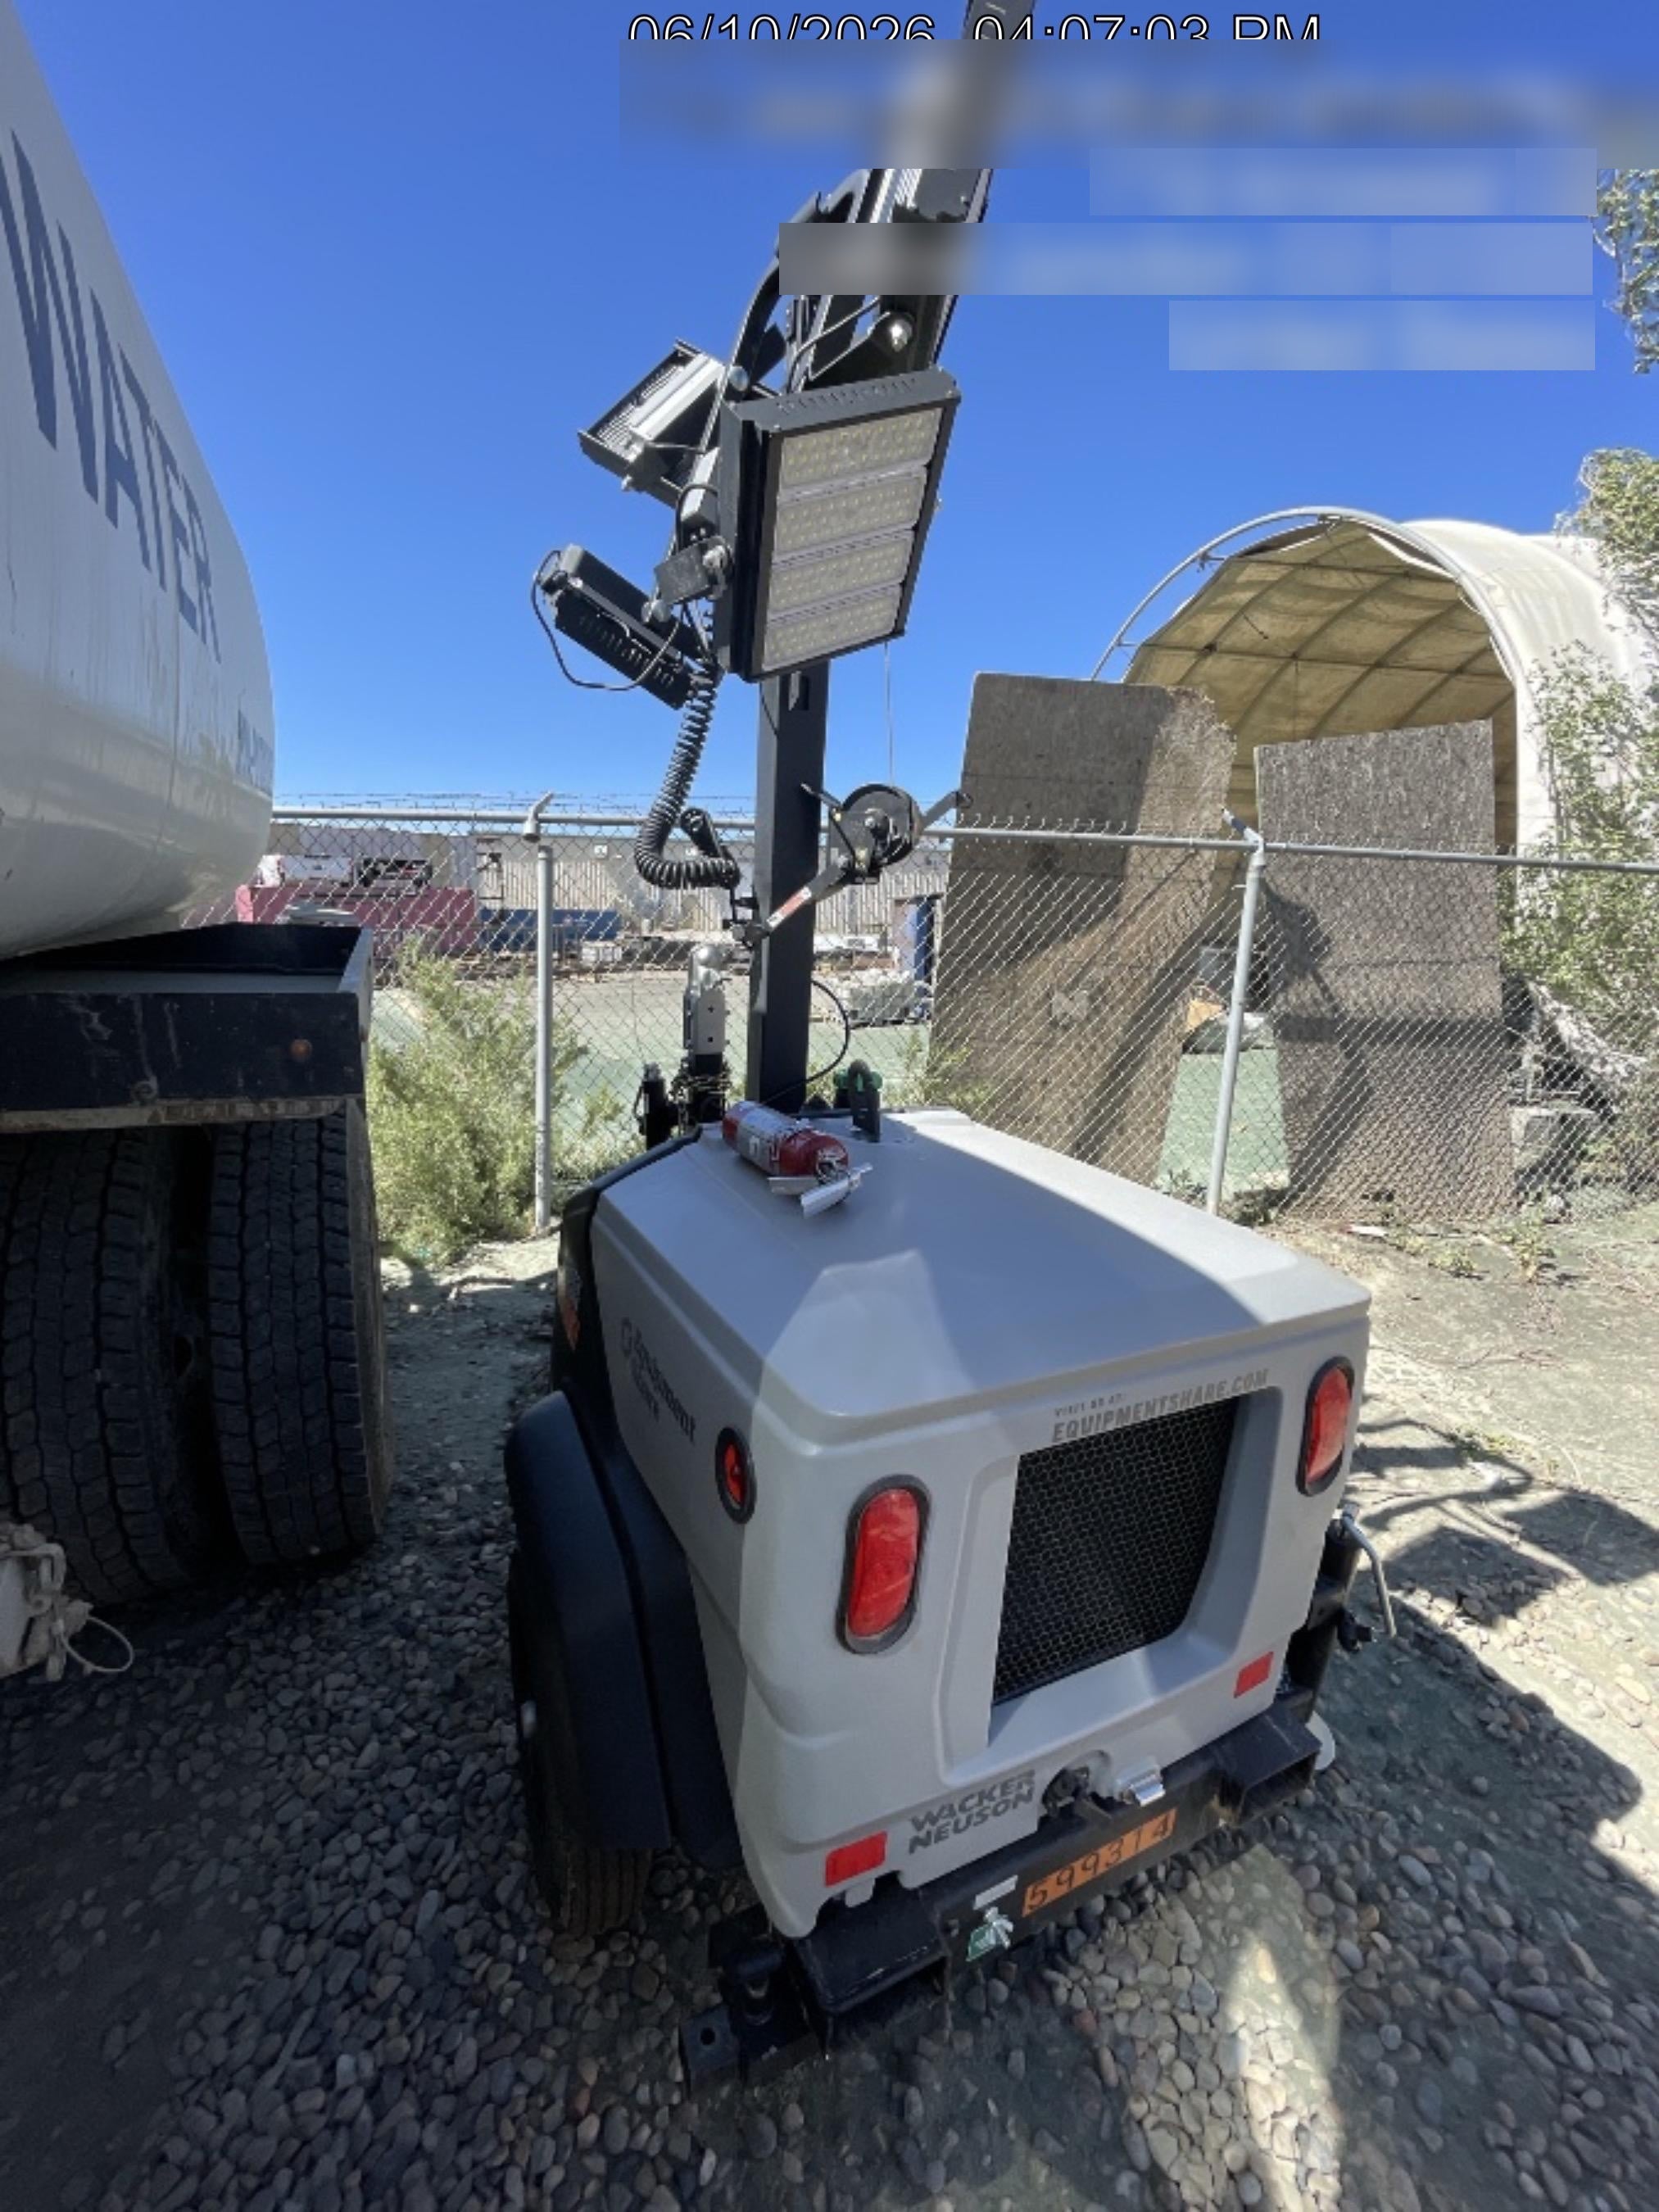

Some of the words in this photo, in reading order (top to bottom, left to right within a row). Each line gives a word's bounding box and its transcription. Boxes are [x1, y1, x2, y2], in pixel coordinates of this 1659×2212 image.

[0, 127, 221, 664] WATER
[1052, 1368, 1269, 1444] EQUIPMENTSHARE.COM
[909, 1779, 1035, 1855] NEUSON
[910, 1769, 1036, 1832] WACKER
[1027, 1812, 1169, 1911] 599314
